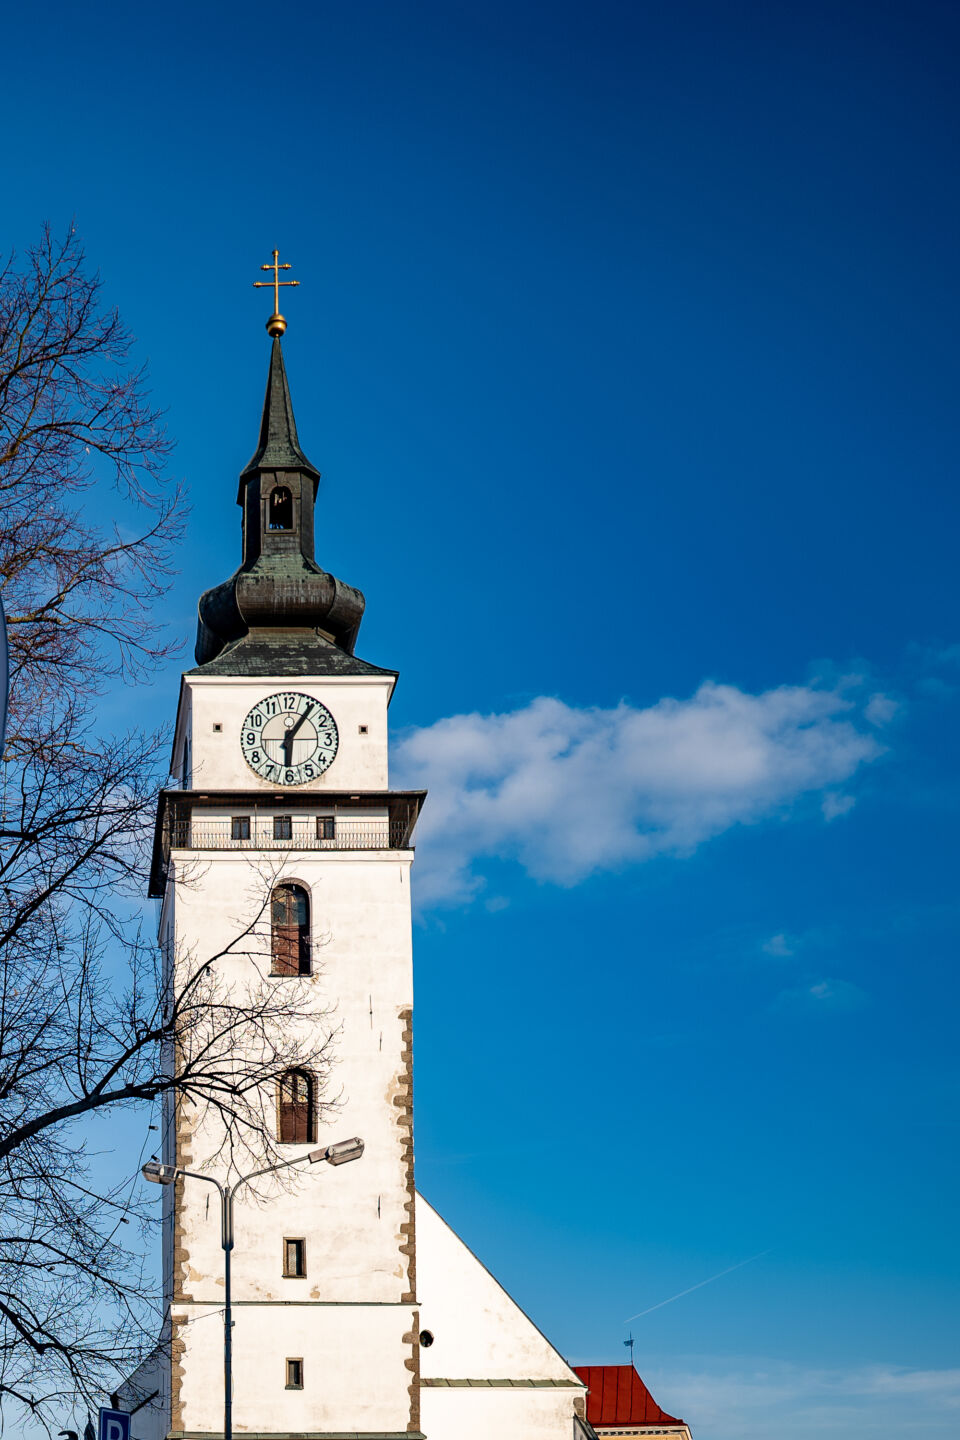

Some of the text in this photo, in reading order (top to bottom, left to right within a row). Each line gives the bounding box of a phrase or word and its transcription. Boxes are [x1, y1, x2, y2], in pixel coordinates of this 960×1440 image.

[266, 702, 276, 714] 11
[284, 697, 295, 709] 12
[250, 714, 262, 727] 10
[318, 715, 327, 727] 2
[246, 733, 255, 745] 9
[324, 733, 332, 746] 3
[252, 751, 260, 763] 8
[318, 752, 326, 765] 4
[266, 765, 274, 777] 7
[285, 770, 294, 782] 6
[305, 765, 313, 777] 5
